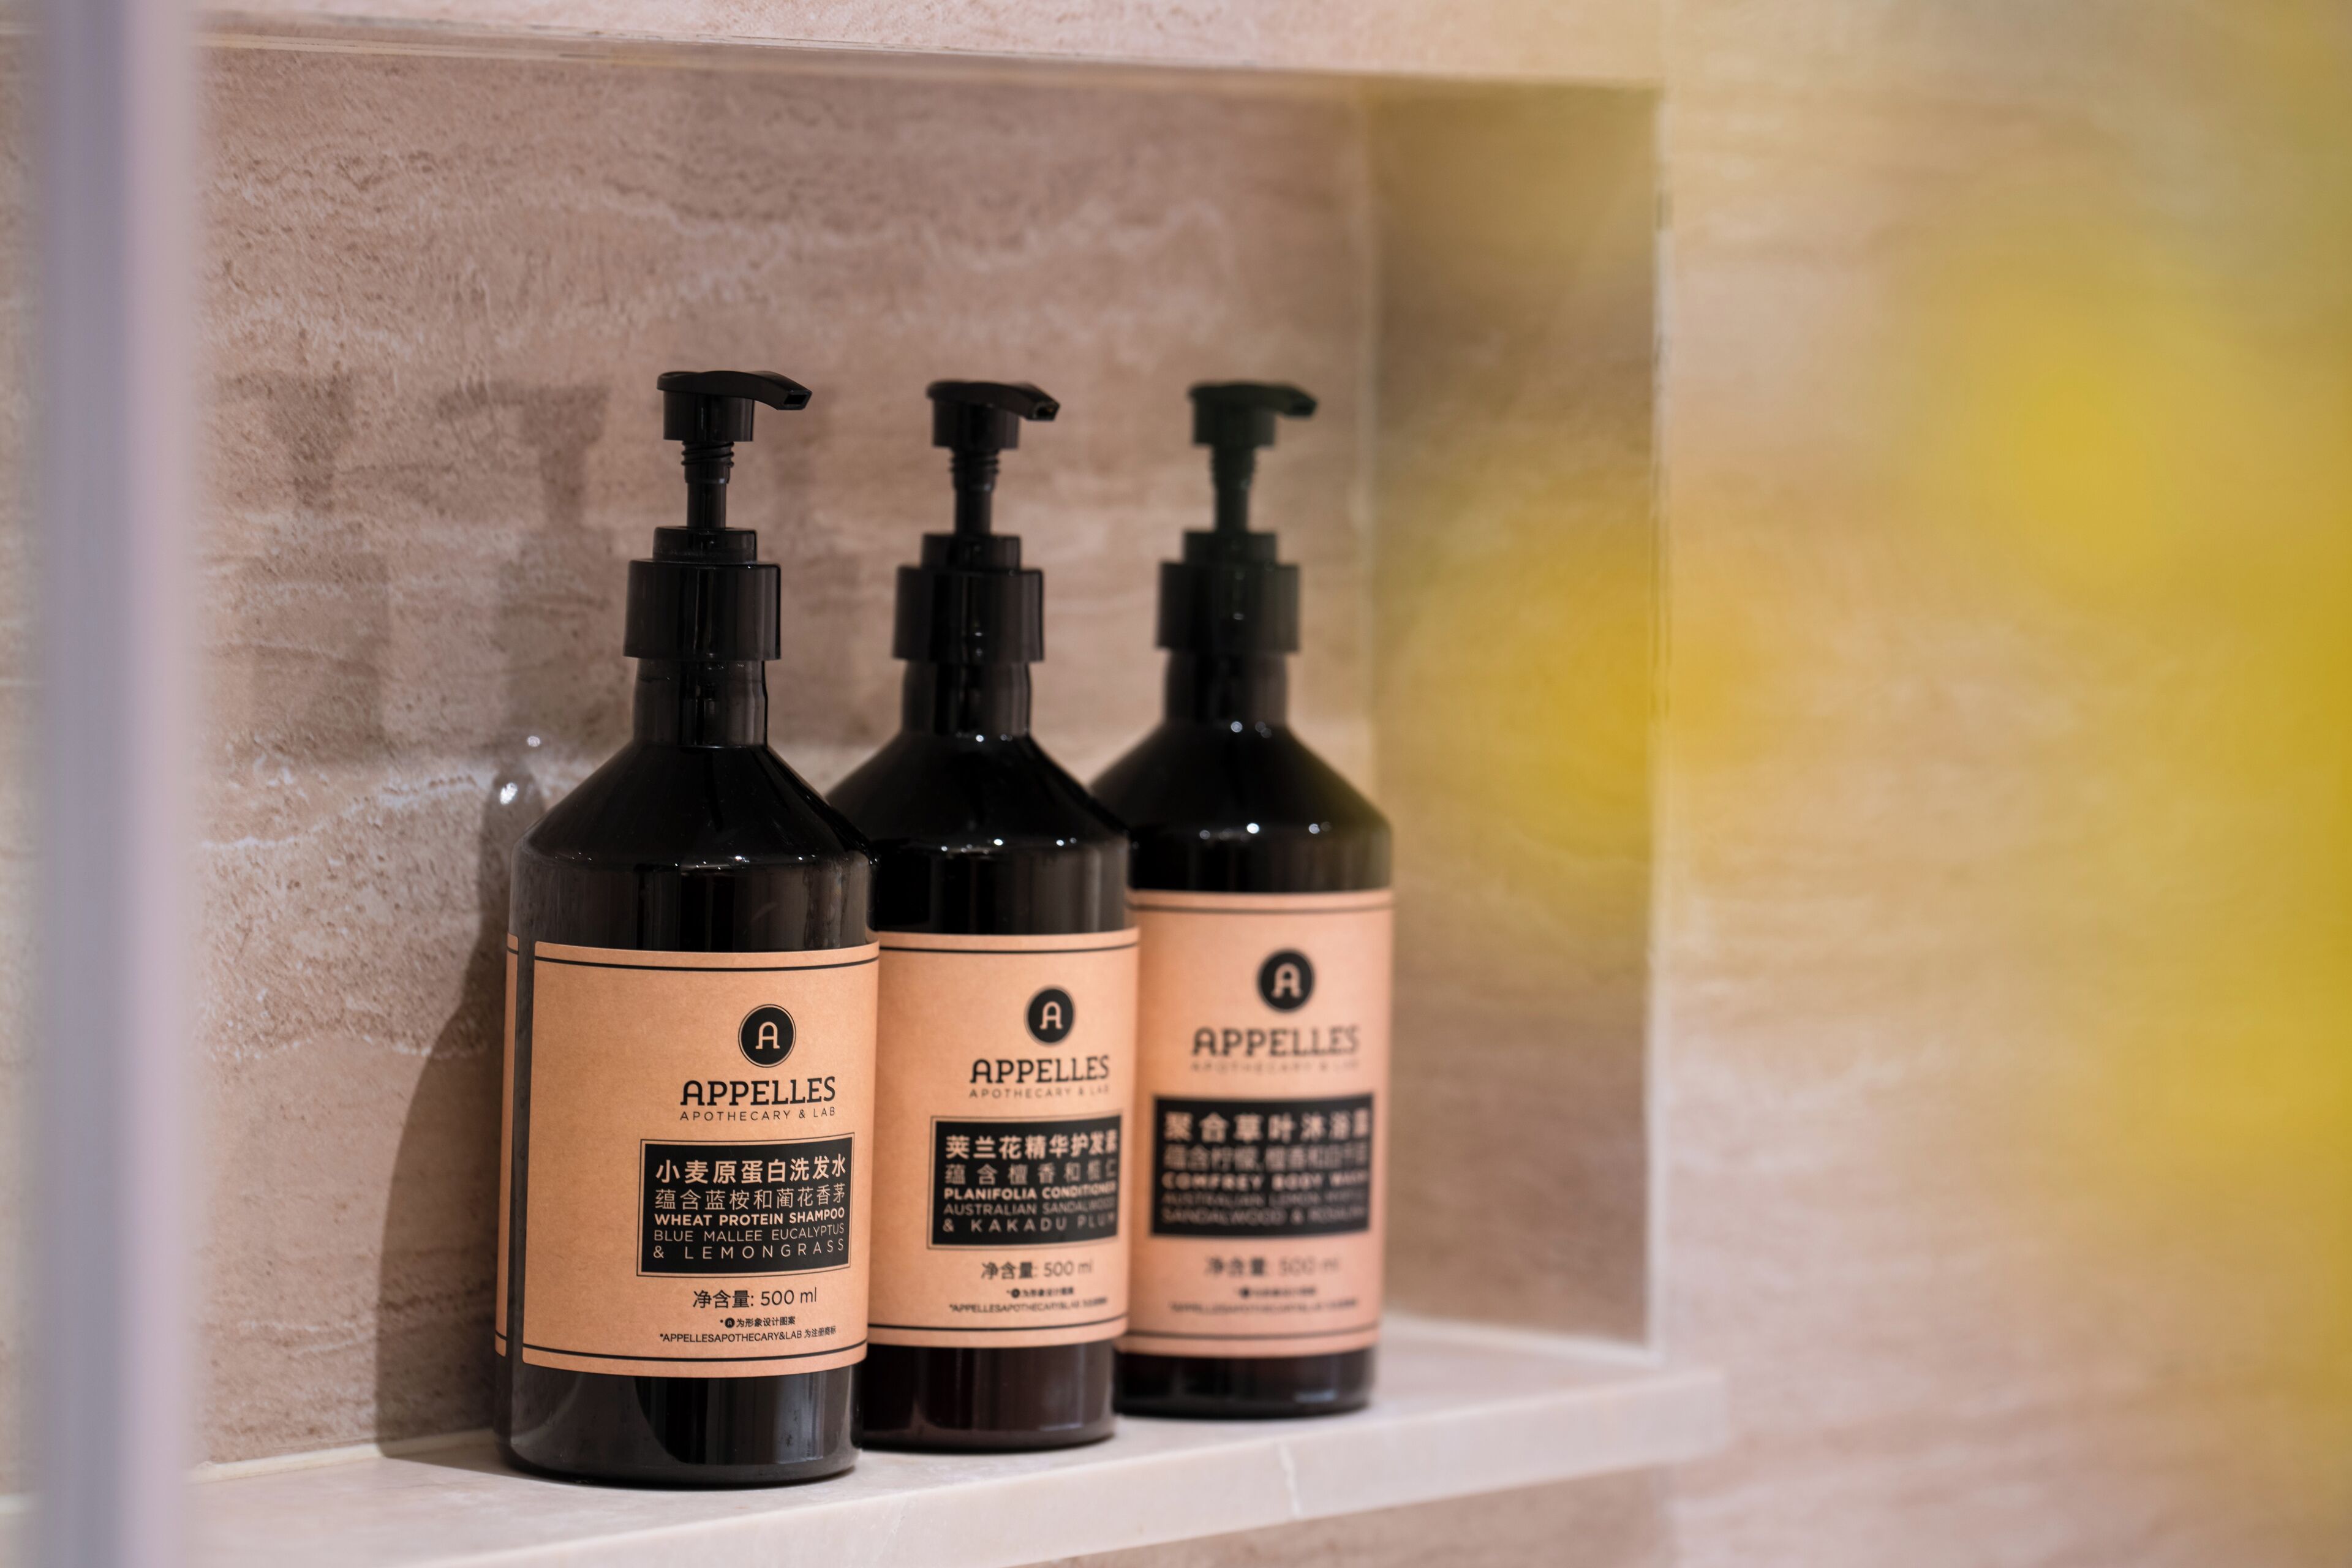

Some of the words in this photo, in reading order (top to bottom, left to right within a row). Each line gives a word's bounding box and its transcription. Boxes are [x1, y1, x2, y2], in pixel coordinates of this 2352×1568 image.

[1039, 1001, 1062, 1029] A
[755, 1021, 780, 1049] A
[1191, 1025, 1360, 1056] APPELLES
[970, 1055, 1109, 1084] APPELLES
[680, 1076, 835, 1106] APPELLES
[969, 1087, 1071, 1098] APOTHECARY
[680, 1110, 790, 1121] APOTHECARY
[799, 1109, 805, 1118] &
[813, 1107, 835, 1118] LAB
[655, 1153, 846, 1184] 小麦原蛋白洗发水
[654, 1183, 845, 1210] 蕴含蓝桉和蔺花香茅
[944, 1188, 1037, 1200] PLANIFOLIA
[654, 1215, 712, 1226] WHEAT
[719, 1213, 783, 1226] PROTEIN
[789, 1207, 844, 1224] SHAMPOO
[943, 1204, 1037, 1215] AUSTRALIAN
[654, 1231, 693, 1242] BLUE
[704, 1230, 762, 1242] MALLEE
[772, 1223, 844, 1240] EUCALYPTUS
[943, 1218, 954, 1232] &
[971, 1218, 1066, 1232] KAKADU
[654, 1246, 664, 1259] &
[685, 1238, 844, 1259] LEMONGRASS
[1043, 1262, 1072, 1277] 500
[693, 1289, 754, 1309] 净含量:
[760, 1289, 794, 1306] 500
[800, 1287, 817, 1303] ml
[804, 1326, 836, 1339] 为注册商标
